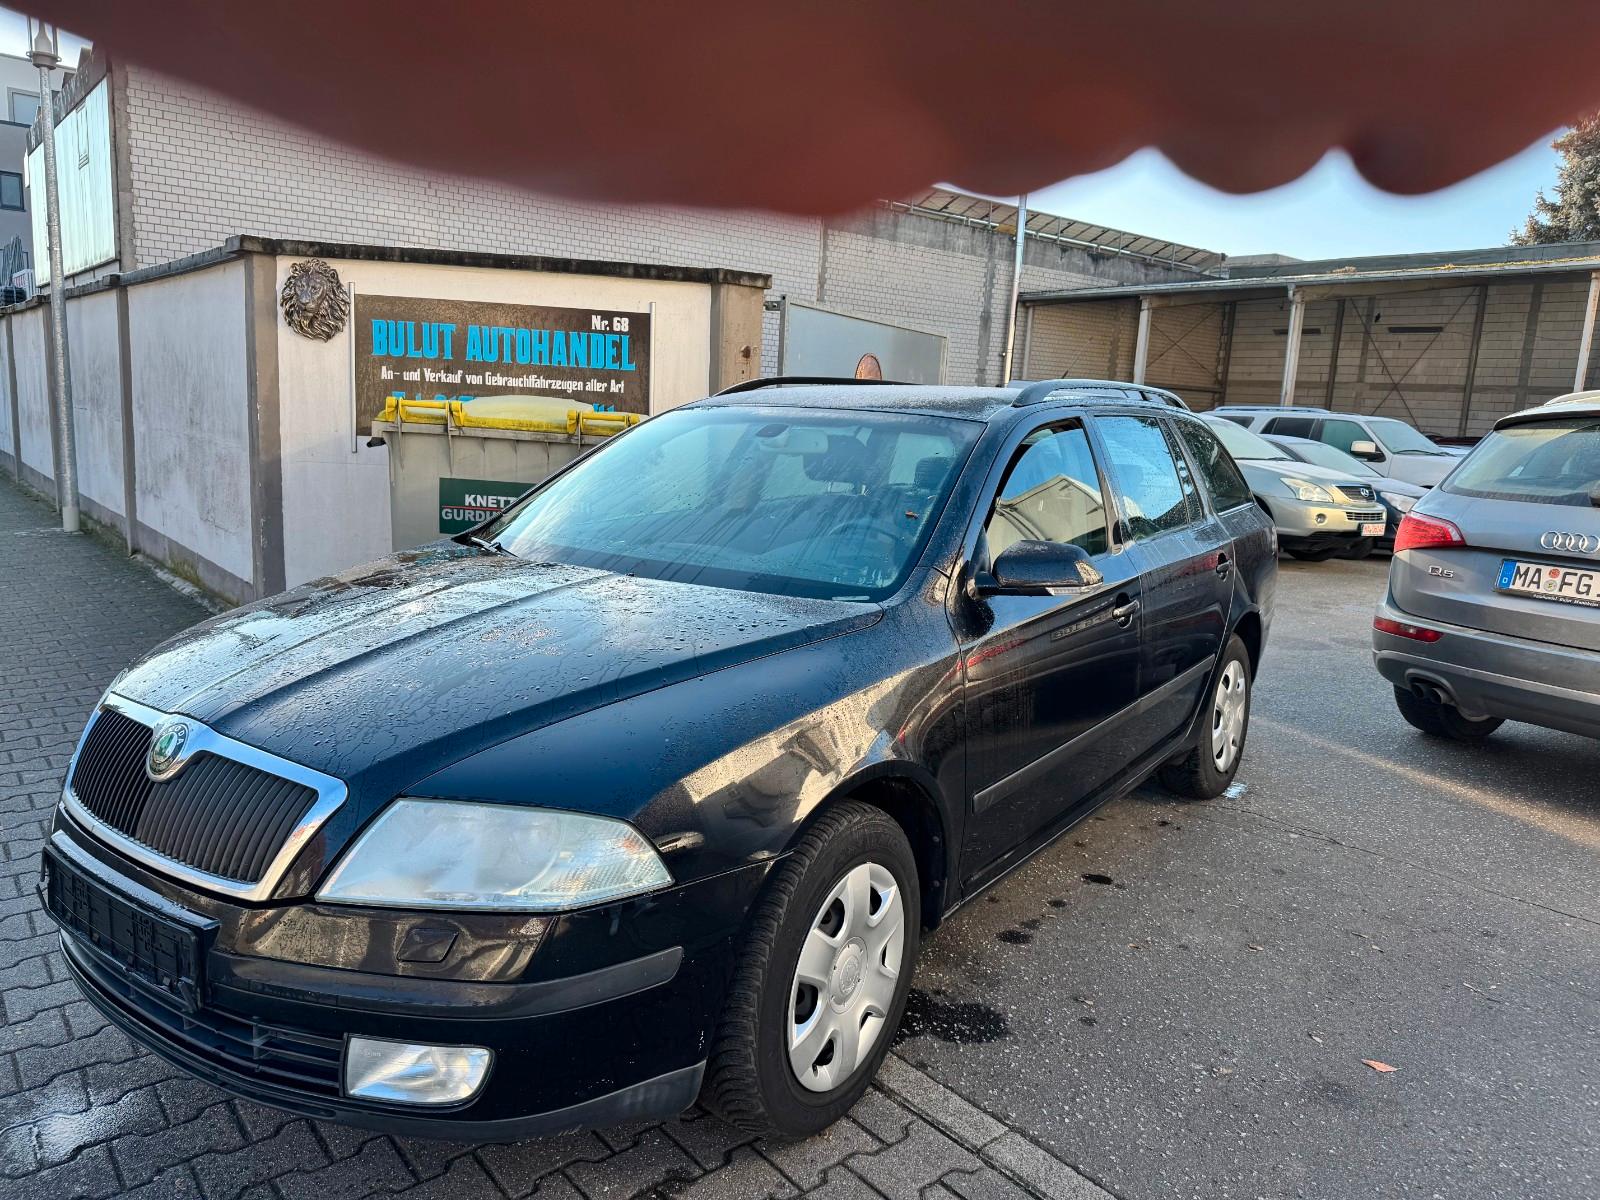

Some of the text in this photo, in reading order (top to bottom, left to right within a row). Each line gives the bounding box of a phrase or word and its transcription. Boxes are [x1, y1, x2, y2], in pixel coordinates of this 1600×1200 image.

[591, 315, 630, 332] Nr. 68
[371, 319, 636, 371] BULUT AUTOHANDEL
[381, 366, 625, 393] An- und Verkauf von Gebrauchtfahrzeugen aller Art
[1429, 565, 1454, 578] Q5
[1512, 565, 1542, 589] MA
[1558, 571, 1594, 596] FG
